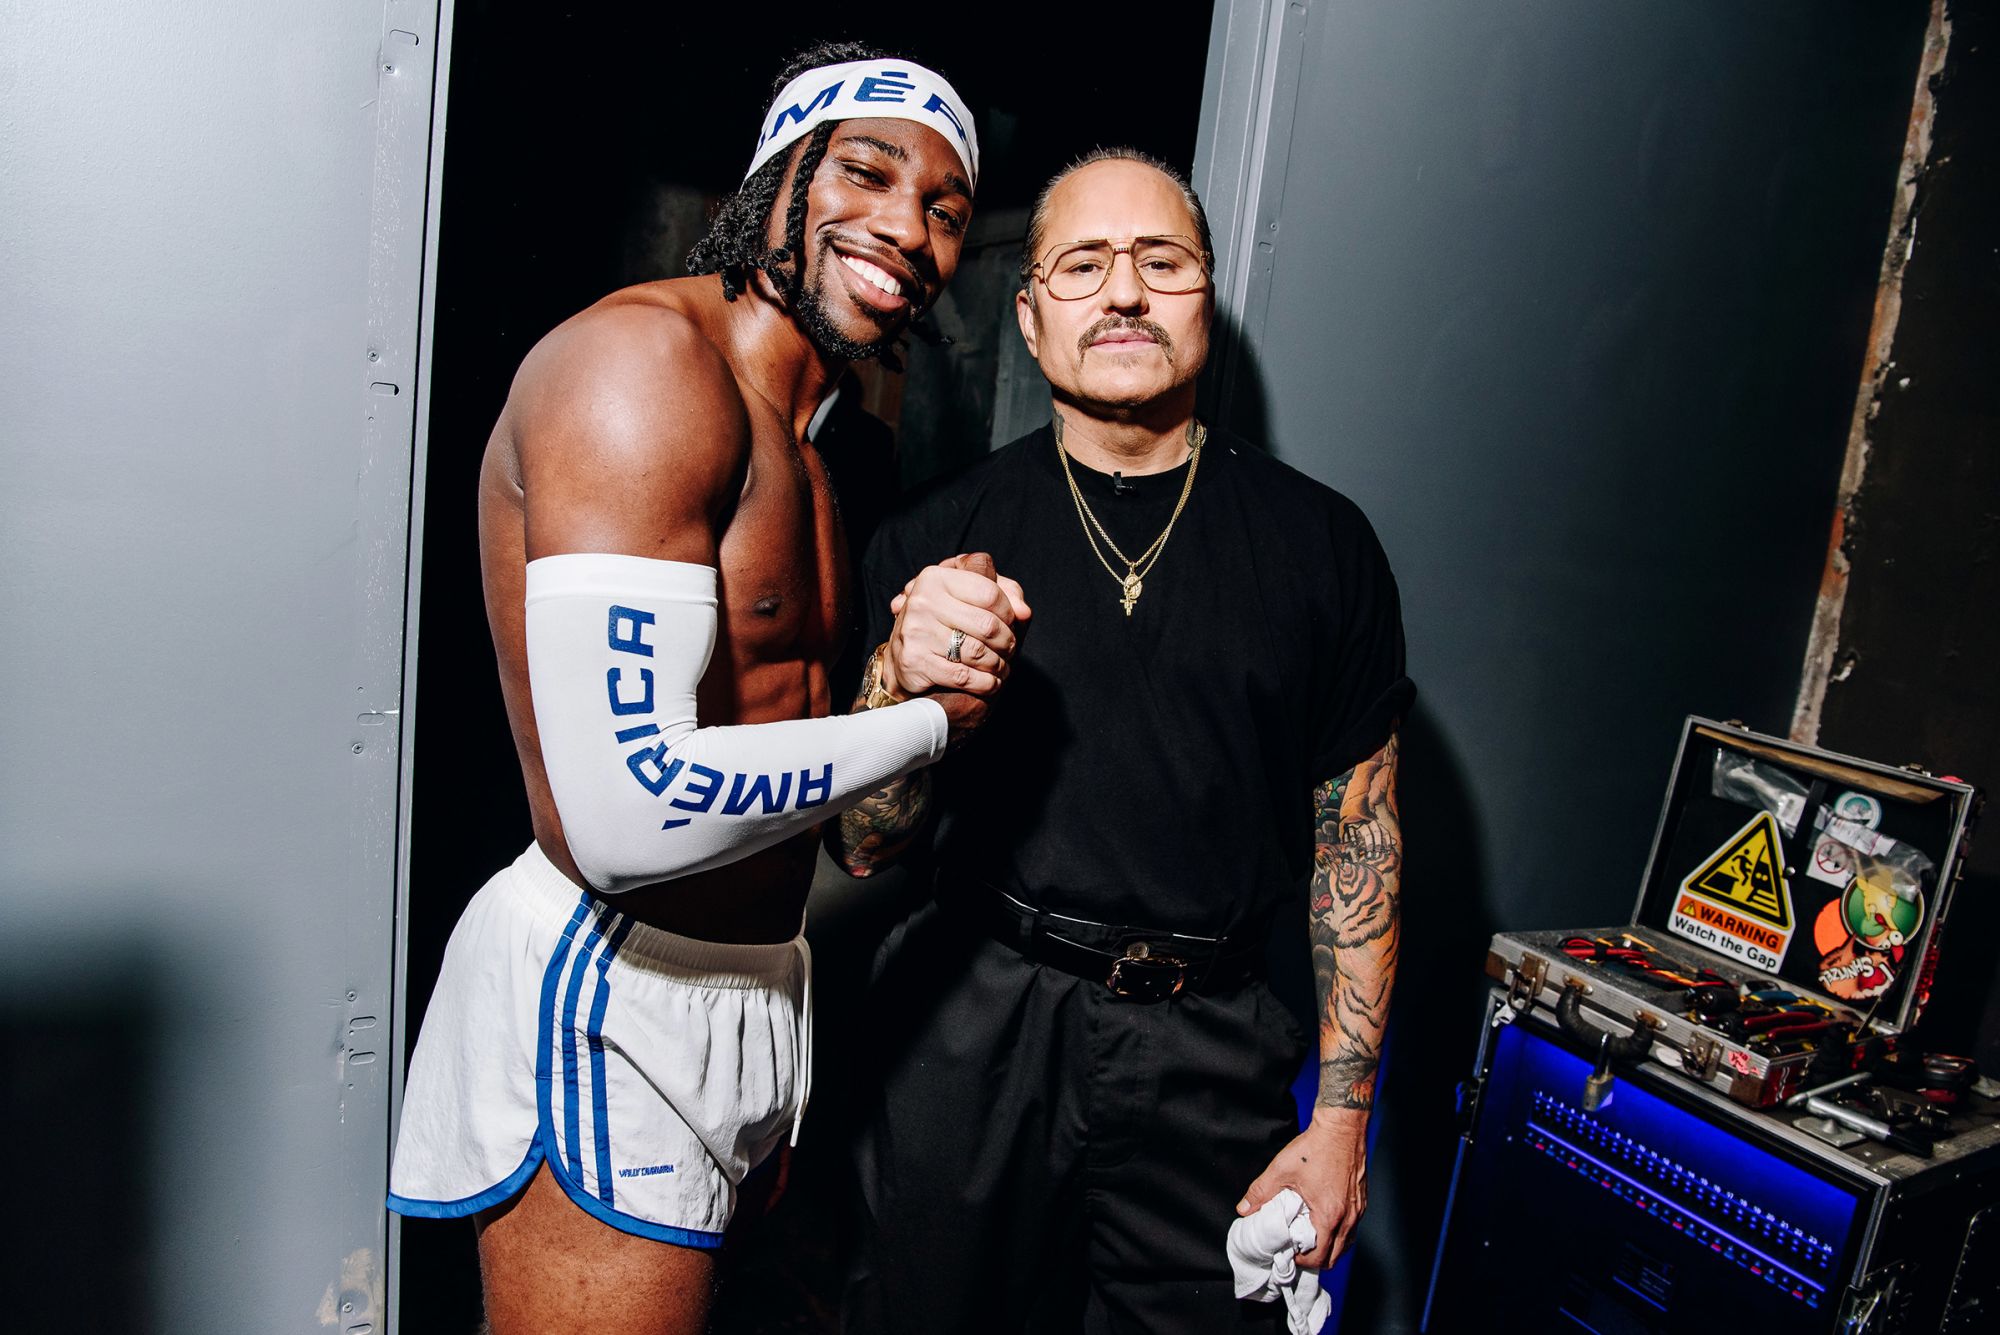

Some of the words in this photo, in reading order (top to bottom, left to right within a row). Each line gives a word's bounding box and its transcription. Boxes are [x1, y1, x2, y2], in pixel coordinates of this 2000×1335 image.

[607, 604, 833, 831] AMÉRICA
[1675, 915, 1717, 943] Watch
[1720, 935, 1743, 954] the
[1746, 946, 1777, 969] Gap
[1700, 906, 1779, 949] WARNING
